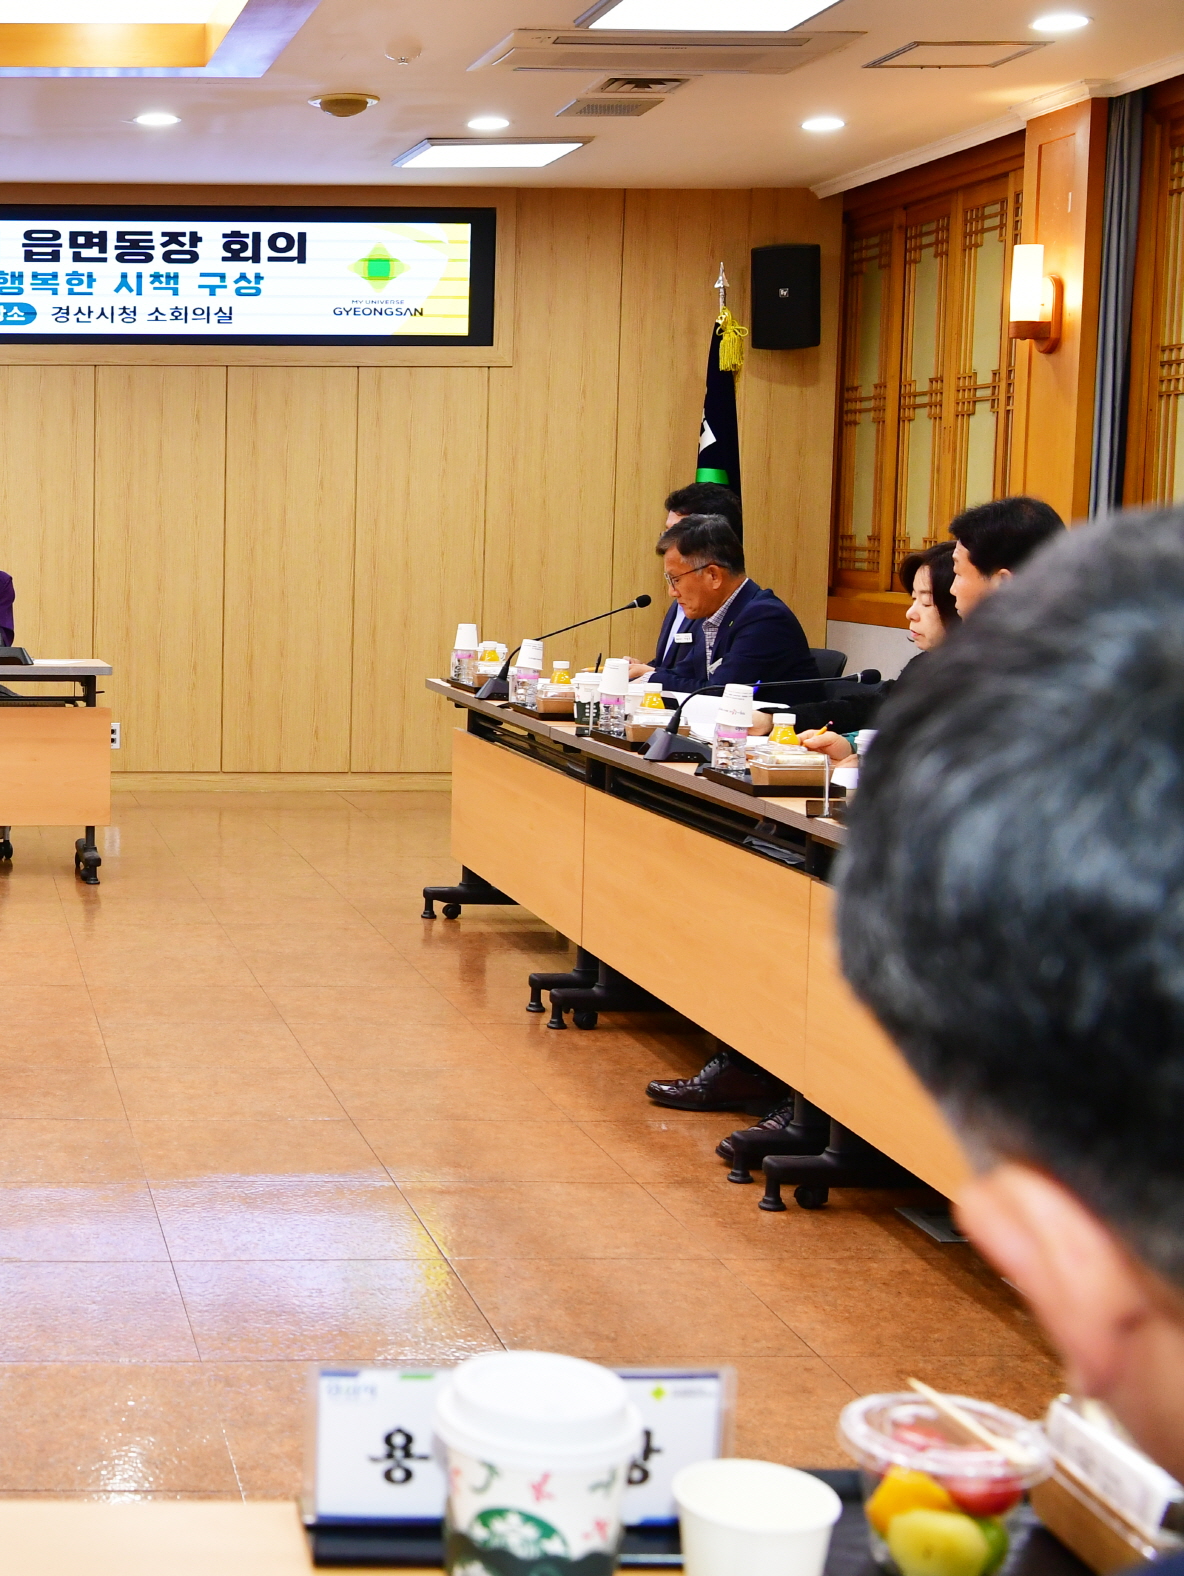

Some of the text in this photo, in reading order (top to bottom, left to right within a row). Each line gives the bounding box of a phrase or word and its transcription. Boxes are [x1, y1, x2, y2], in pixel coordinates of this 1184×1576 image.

[21, 230, 203, 265] 읍면동장
[221, 230, 308, 265] 회의
[113, 271, 180, 297] 시책
[197, 272, 265, 297] 구상
[51, 305, 234, 325] 경산시청 소회의실
[332, 307, 424, 317] GYEONGSAN
[368, 1427, 430, 1485] 용
